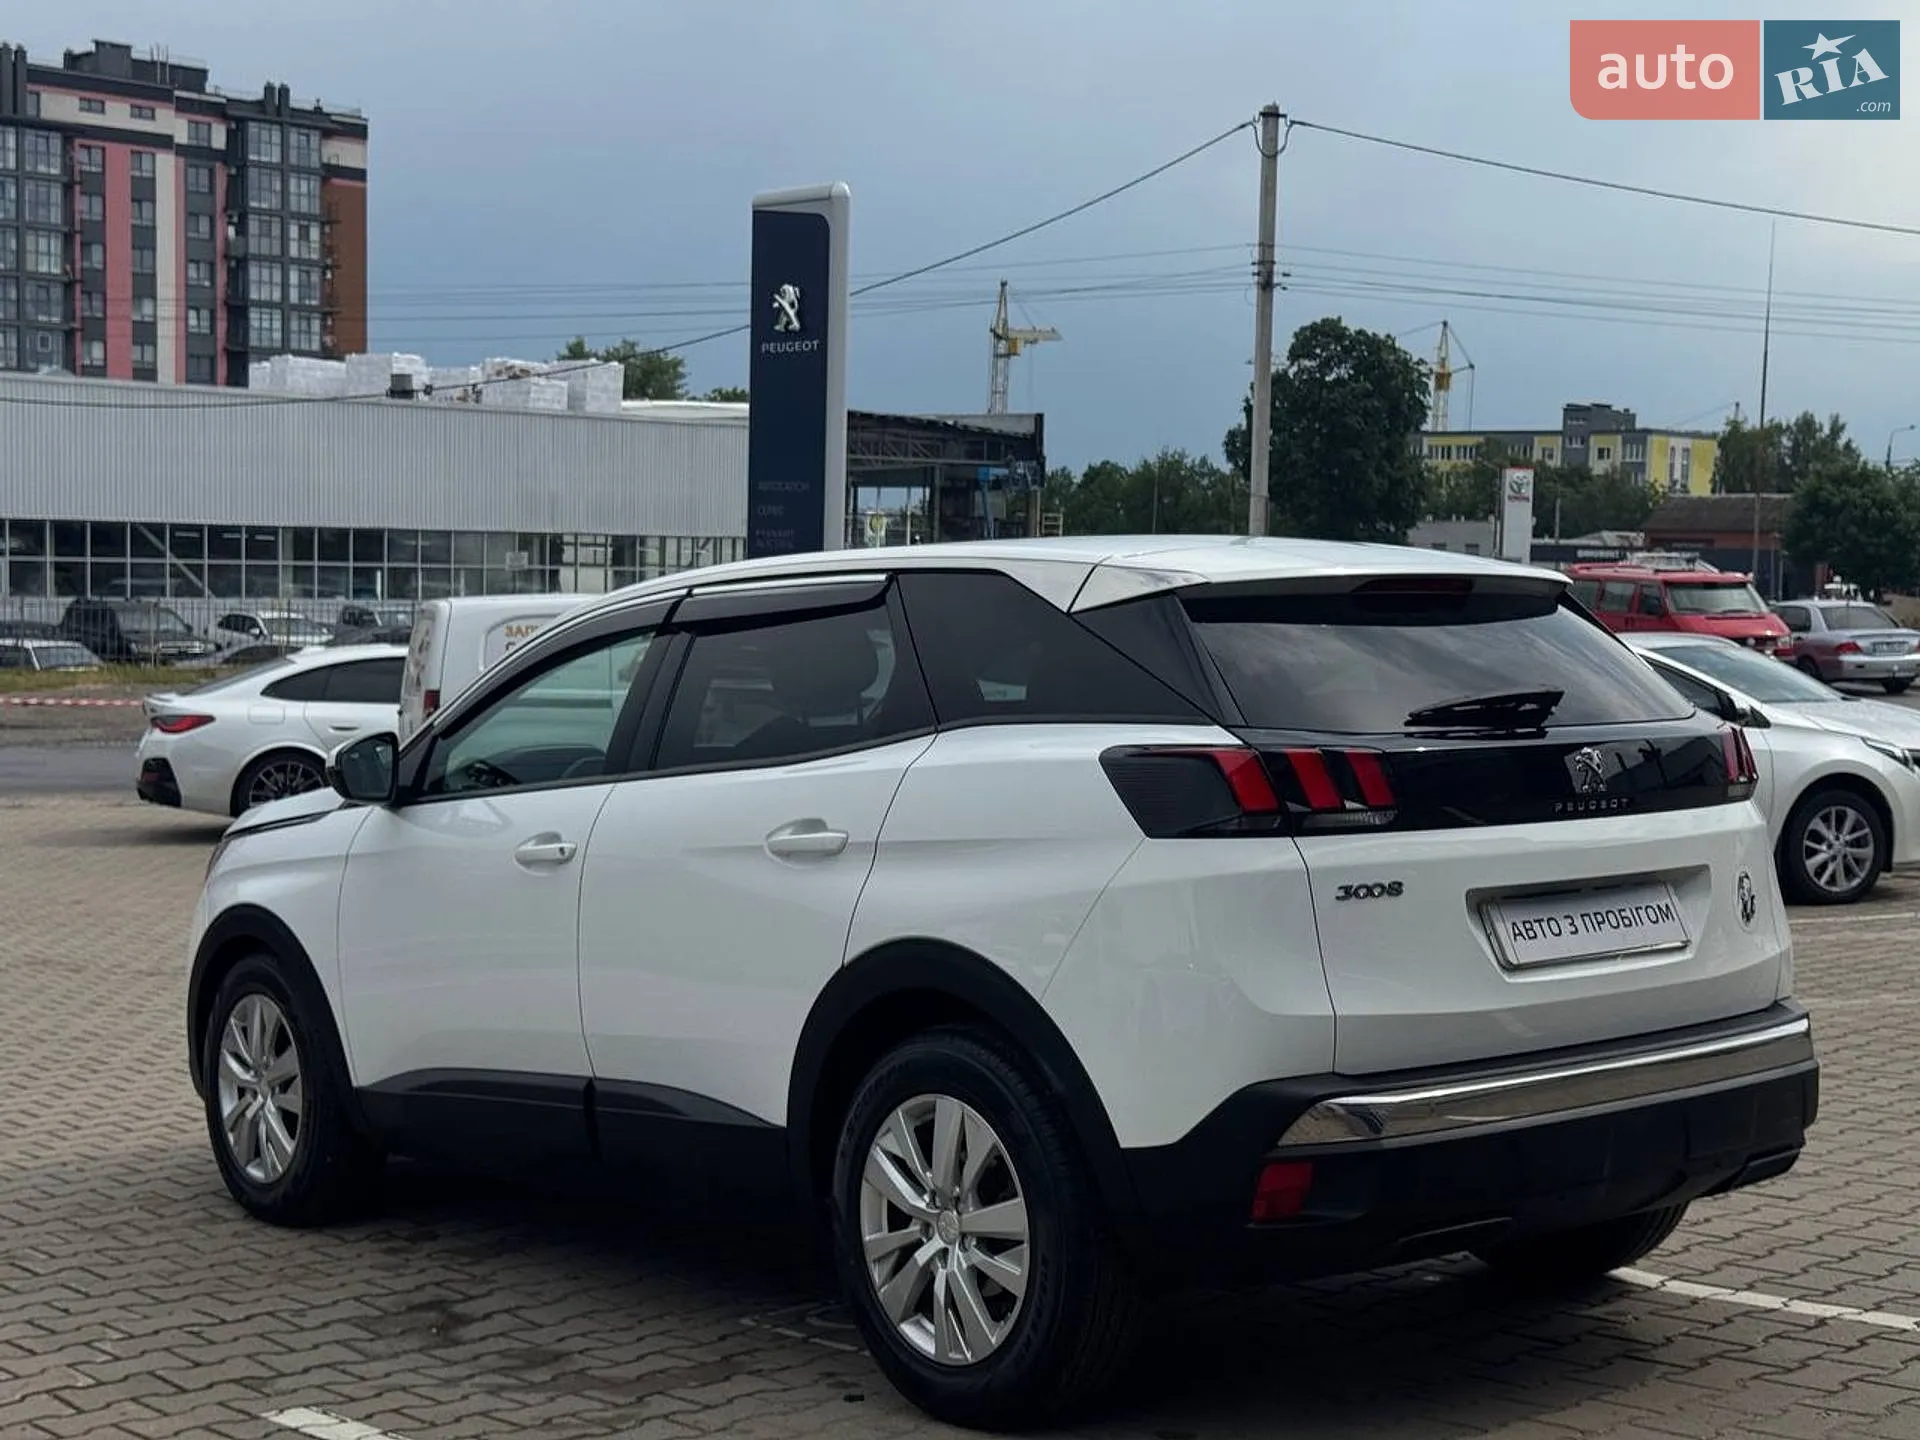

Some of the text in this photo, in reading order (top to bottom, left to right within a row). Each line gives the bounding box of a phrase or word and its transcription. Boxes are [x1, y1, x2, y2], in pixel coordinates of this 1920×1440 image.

[761, 340, 819, 353] PEUGEOT
[1554, 798, 1629, 815] PEUGEOT
[1335, 881, 1404, 901] 3008
[1511, 917, 1562, 942] АВТО
[1580, 903, 1676, 934] ПРОБІГОМ
